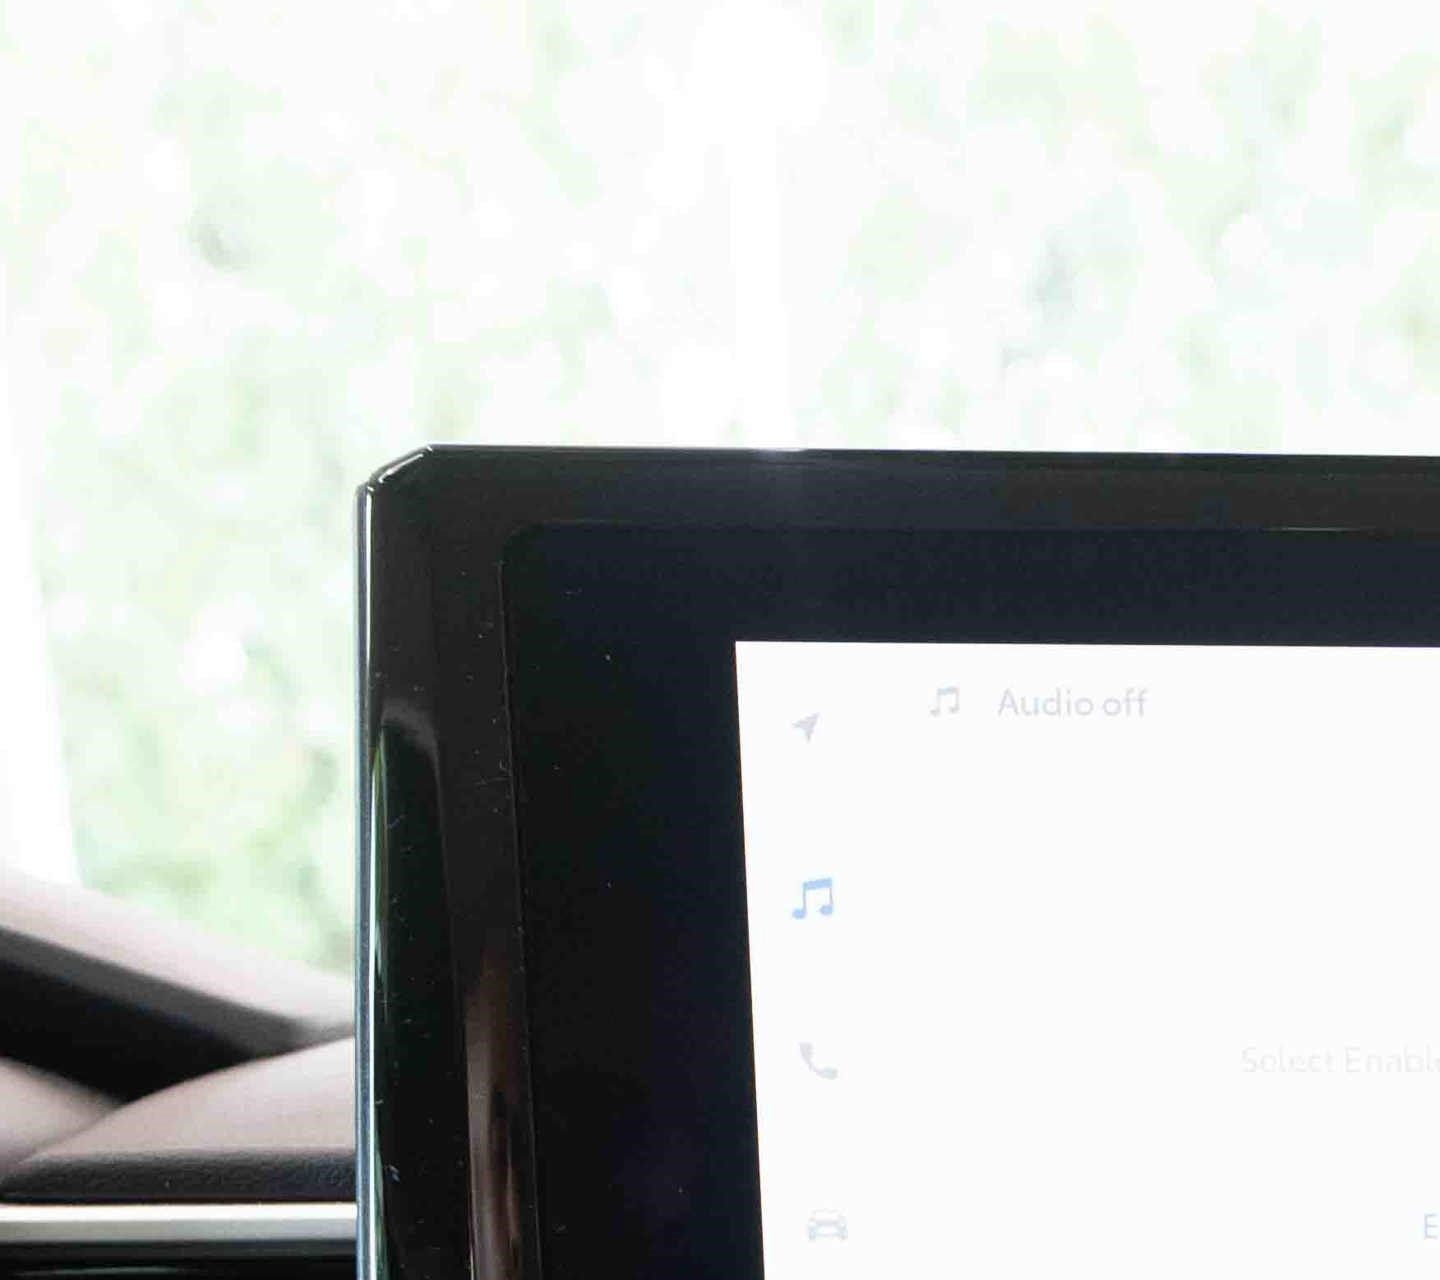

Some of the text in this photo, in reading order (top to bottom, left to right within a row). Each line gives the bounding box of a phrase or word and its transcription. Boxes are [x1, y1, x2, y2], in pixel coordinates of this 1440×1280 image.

[997, 686, 1148, 717] Audio off
[1240, 1042, 1336, 1074] Select
